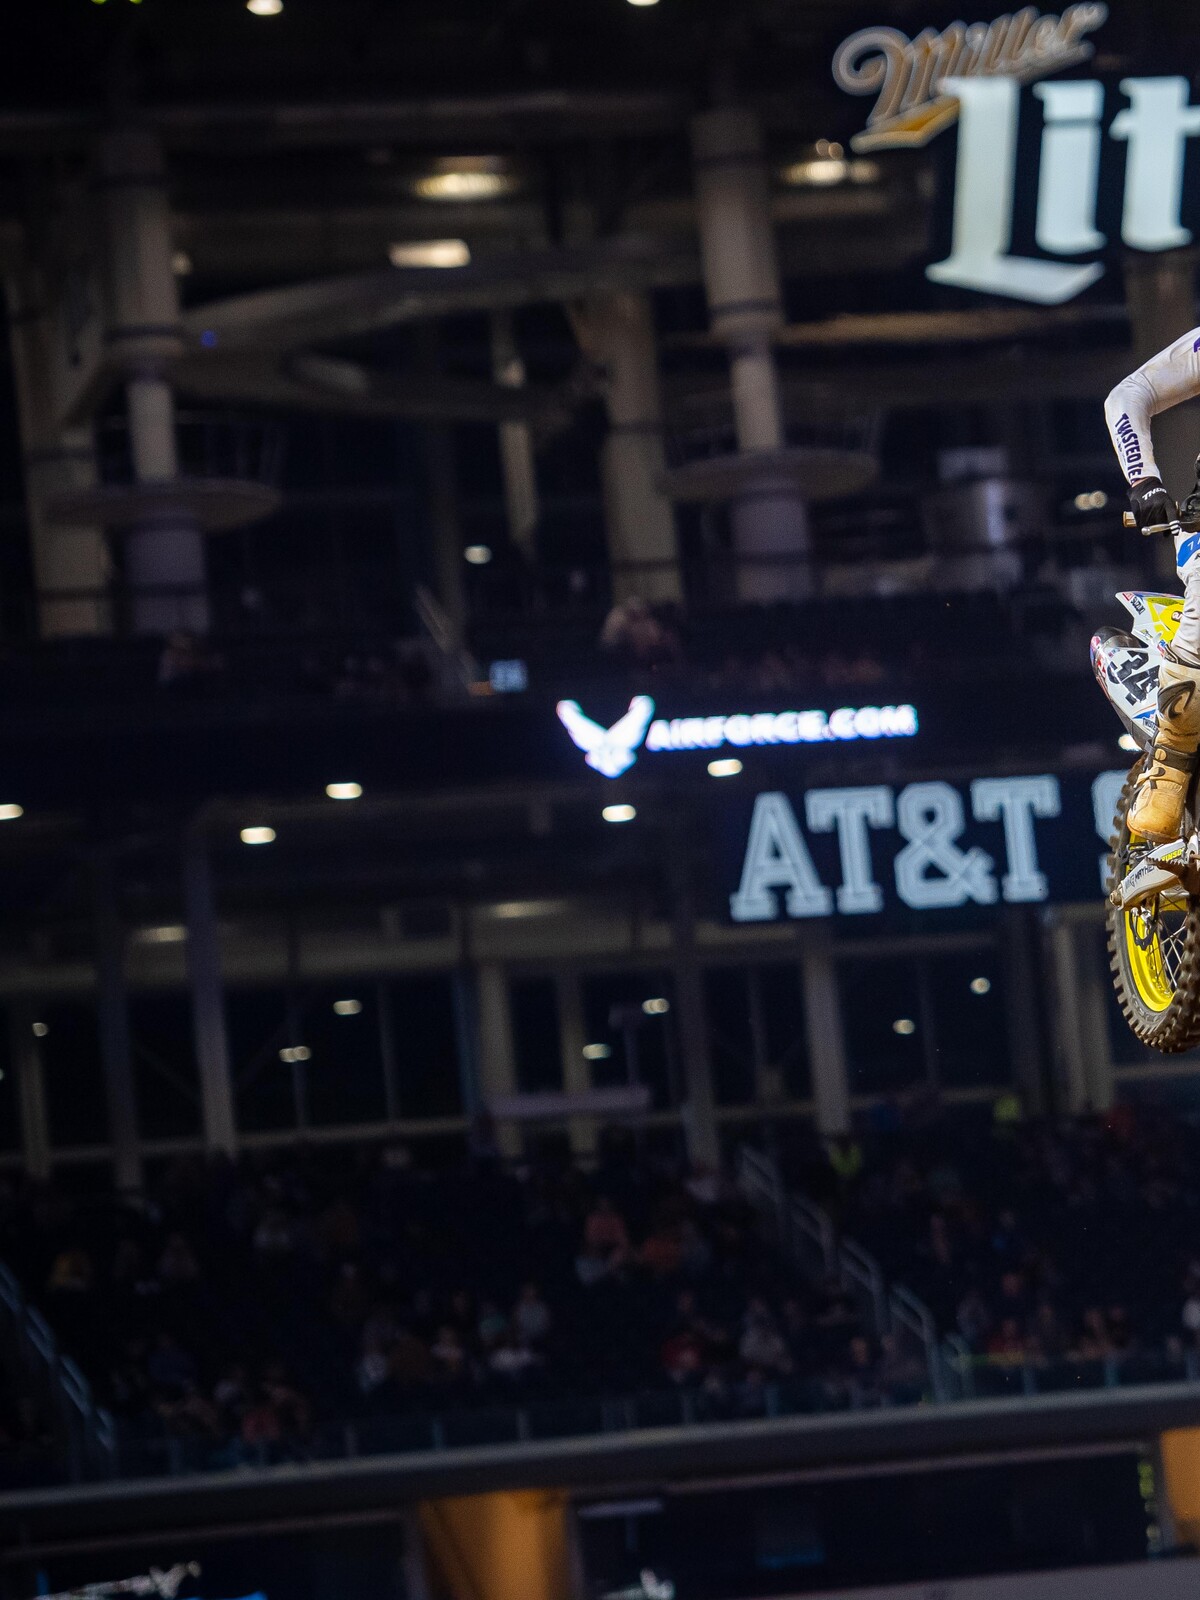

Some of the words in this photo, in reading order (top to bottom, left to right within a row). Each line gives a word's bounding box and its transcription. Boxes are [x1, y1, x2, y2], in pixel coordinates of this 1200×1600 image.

[832, 2, 1108, 130] Miller
[1115, 413, 1142, 464] TWISTED
[1107, 646, 1160, 706] 34
[646, 704, 918, 751] AIRFORCE.COM
[730, 773, 1062, 922] AT&T
